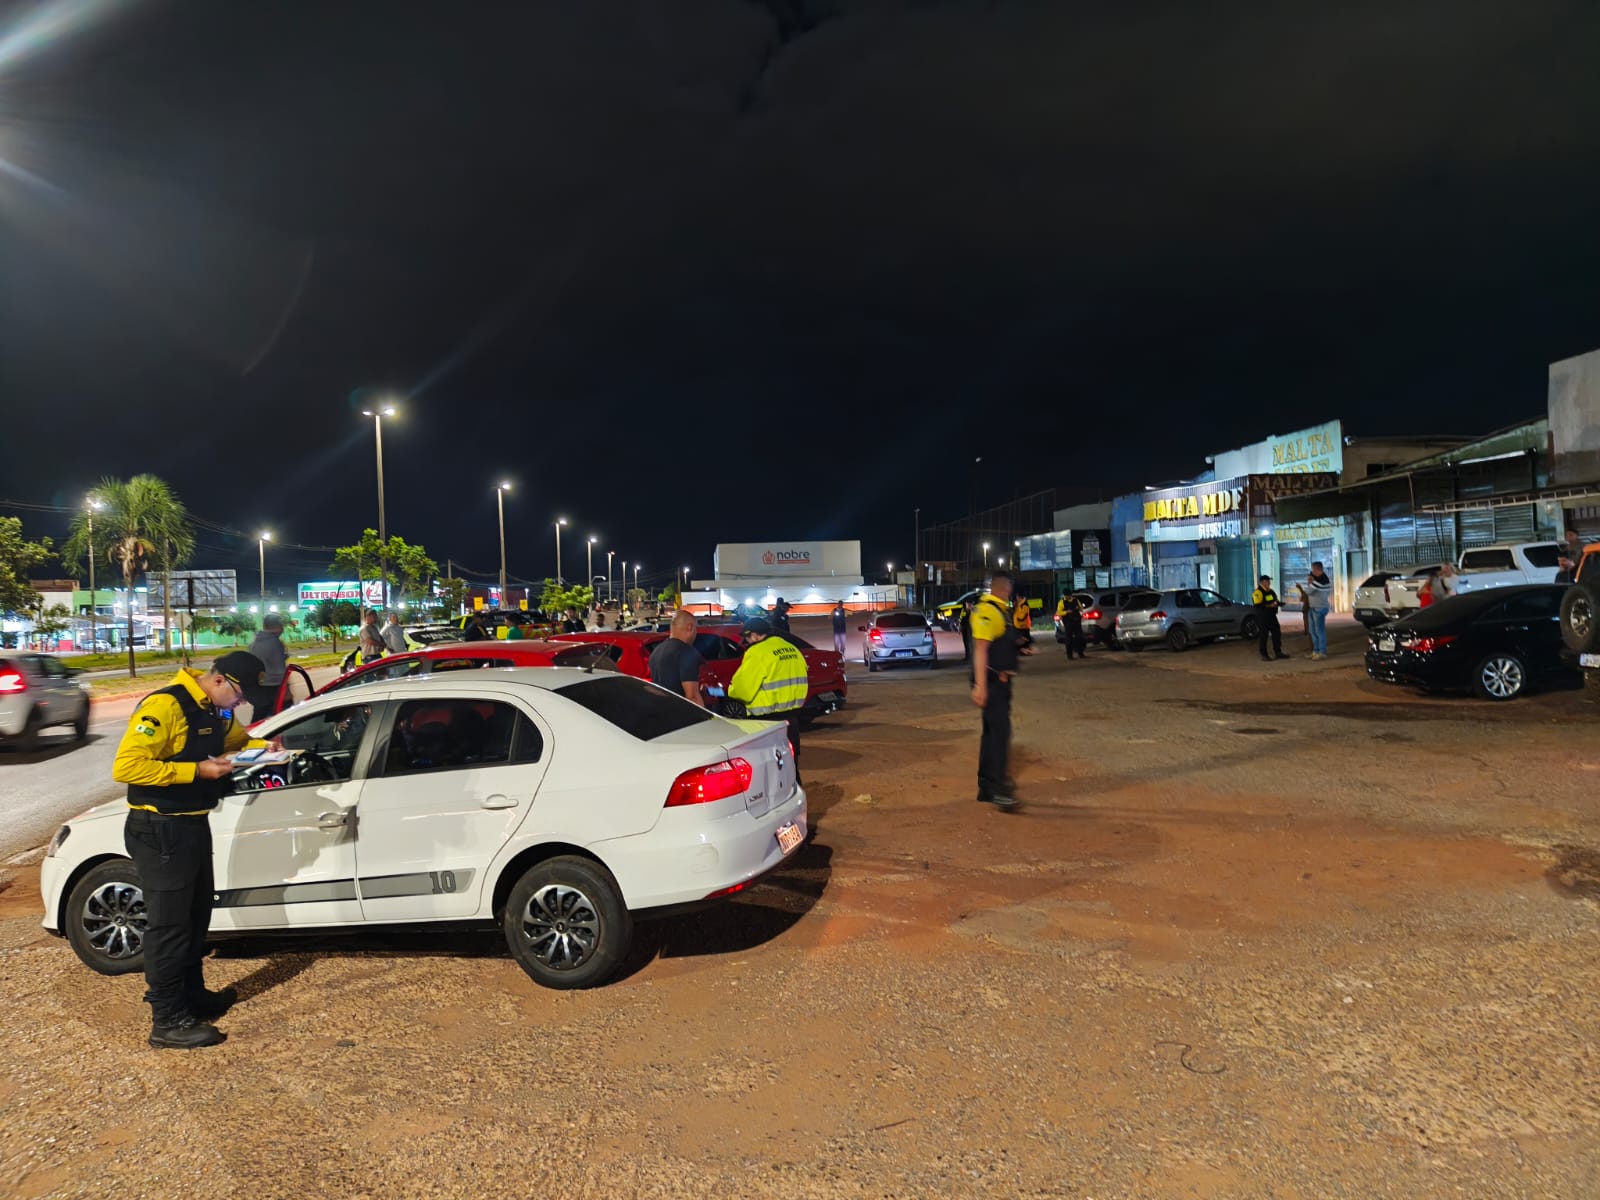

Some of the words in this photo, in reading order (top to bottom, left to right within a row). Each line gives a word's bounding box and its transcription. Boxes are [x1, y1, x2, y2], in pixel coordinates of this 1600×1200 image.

[1272, 431, 1334, 467] MALTA
[776, 549, 810, 560] nobre
[429, 870, 457, 895] 10
